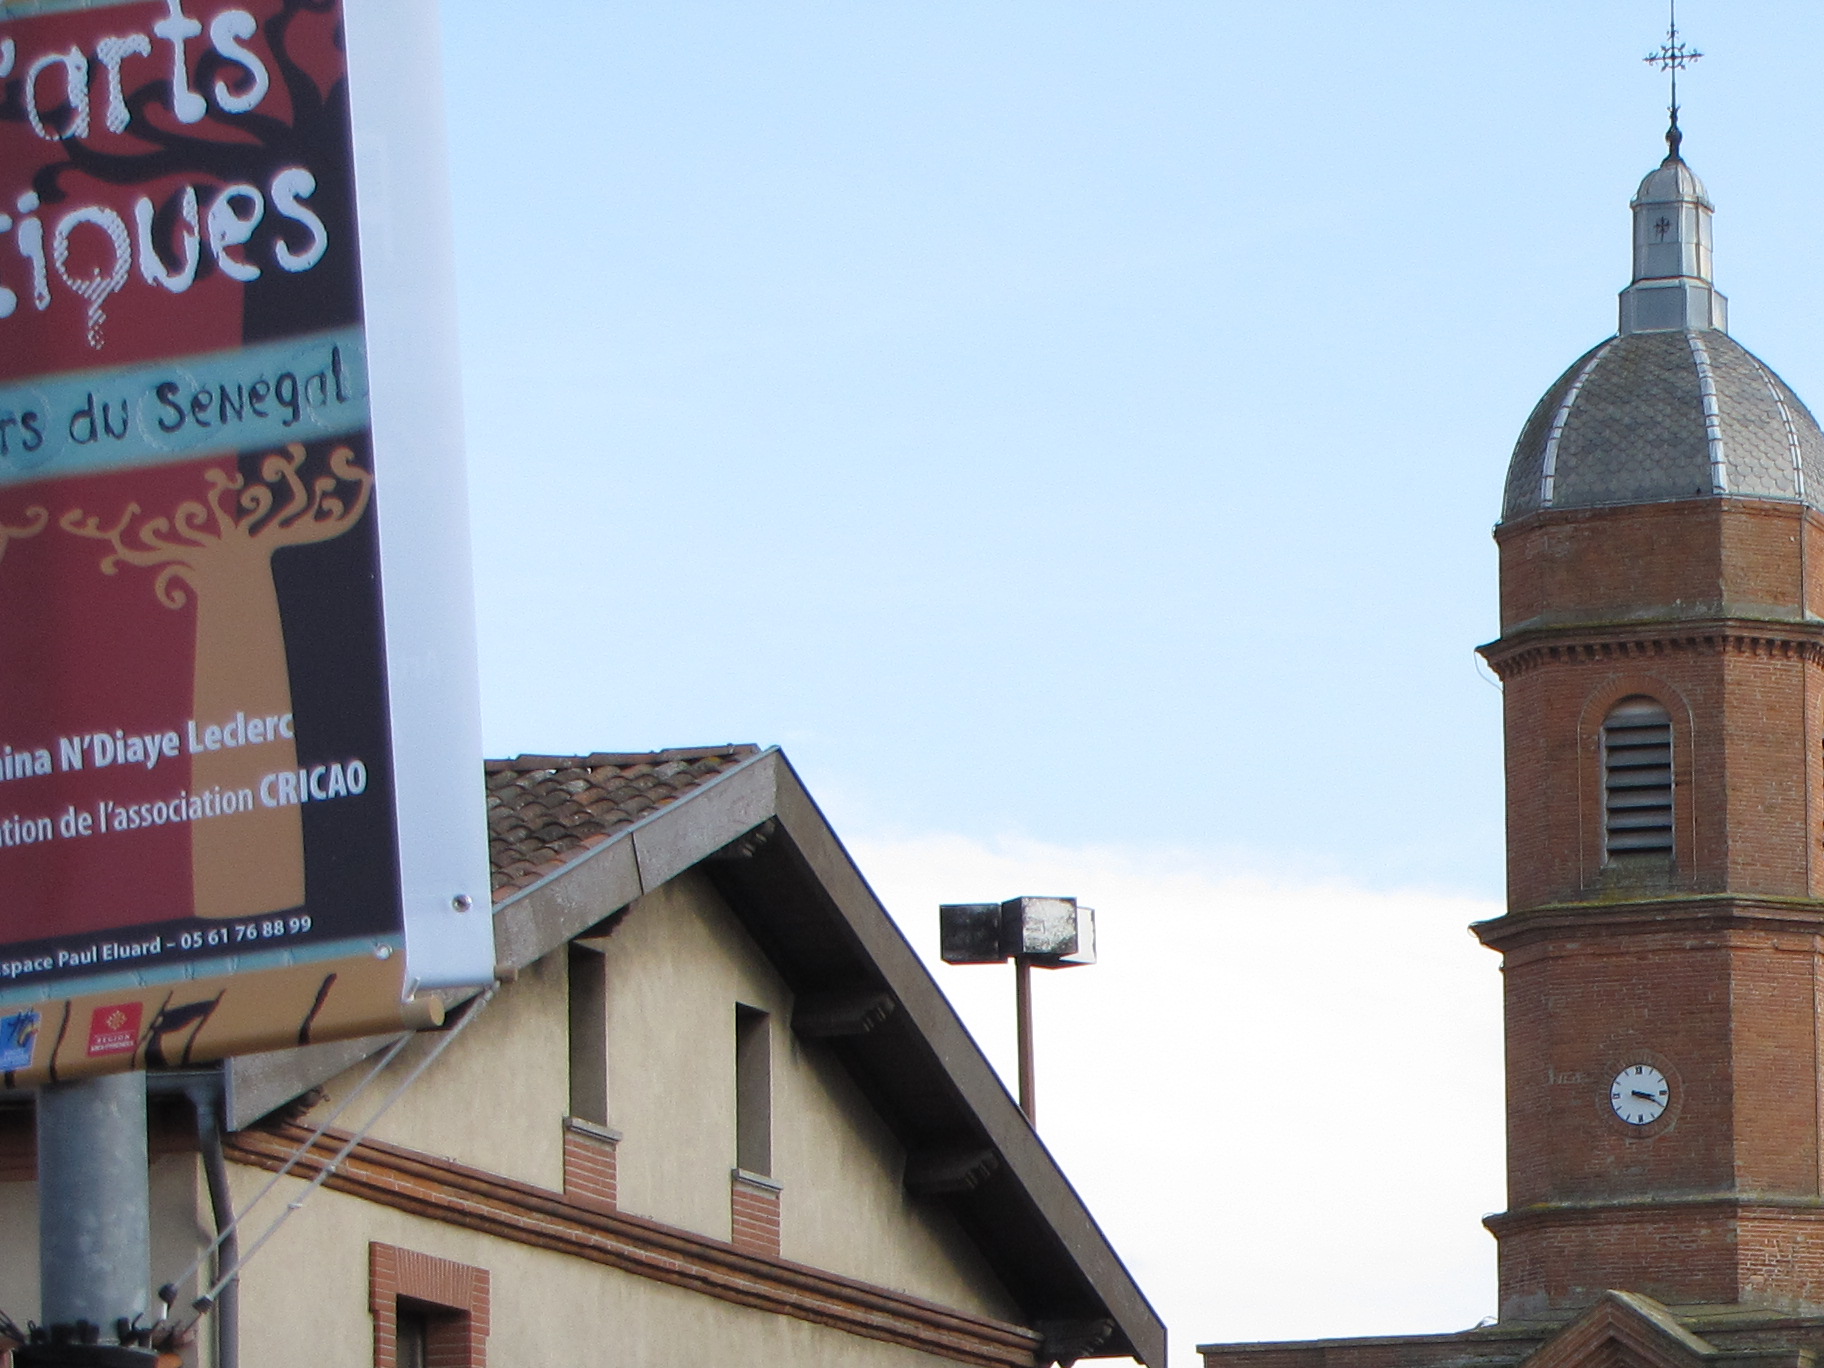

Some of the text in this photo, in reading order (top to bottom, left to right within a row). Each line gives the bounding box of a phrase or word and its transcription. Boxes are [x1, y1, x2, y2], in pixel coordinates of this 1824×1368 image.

[69, 391, 129, 446] du
[59, 730, 181, 771] N'Diaye
[187, 711, 296, 754] Leclerc
[0, 759, 368, 848] tion de l'association CRICAO
[58, 945, 99, 967] Paul
[102, 936, 162, 961] Eluard
[181, 931, 203, 950] 05
[208, 927, 229, 946] 61
[235, 924, 258, 942] 76
[262, 919, 285, 938] 88
[289, 915, 313, 935] 99
